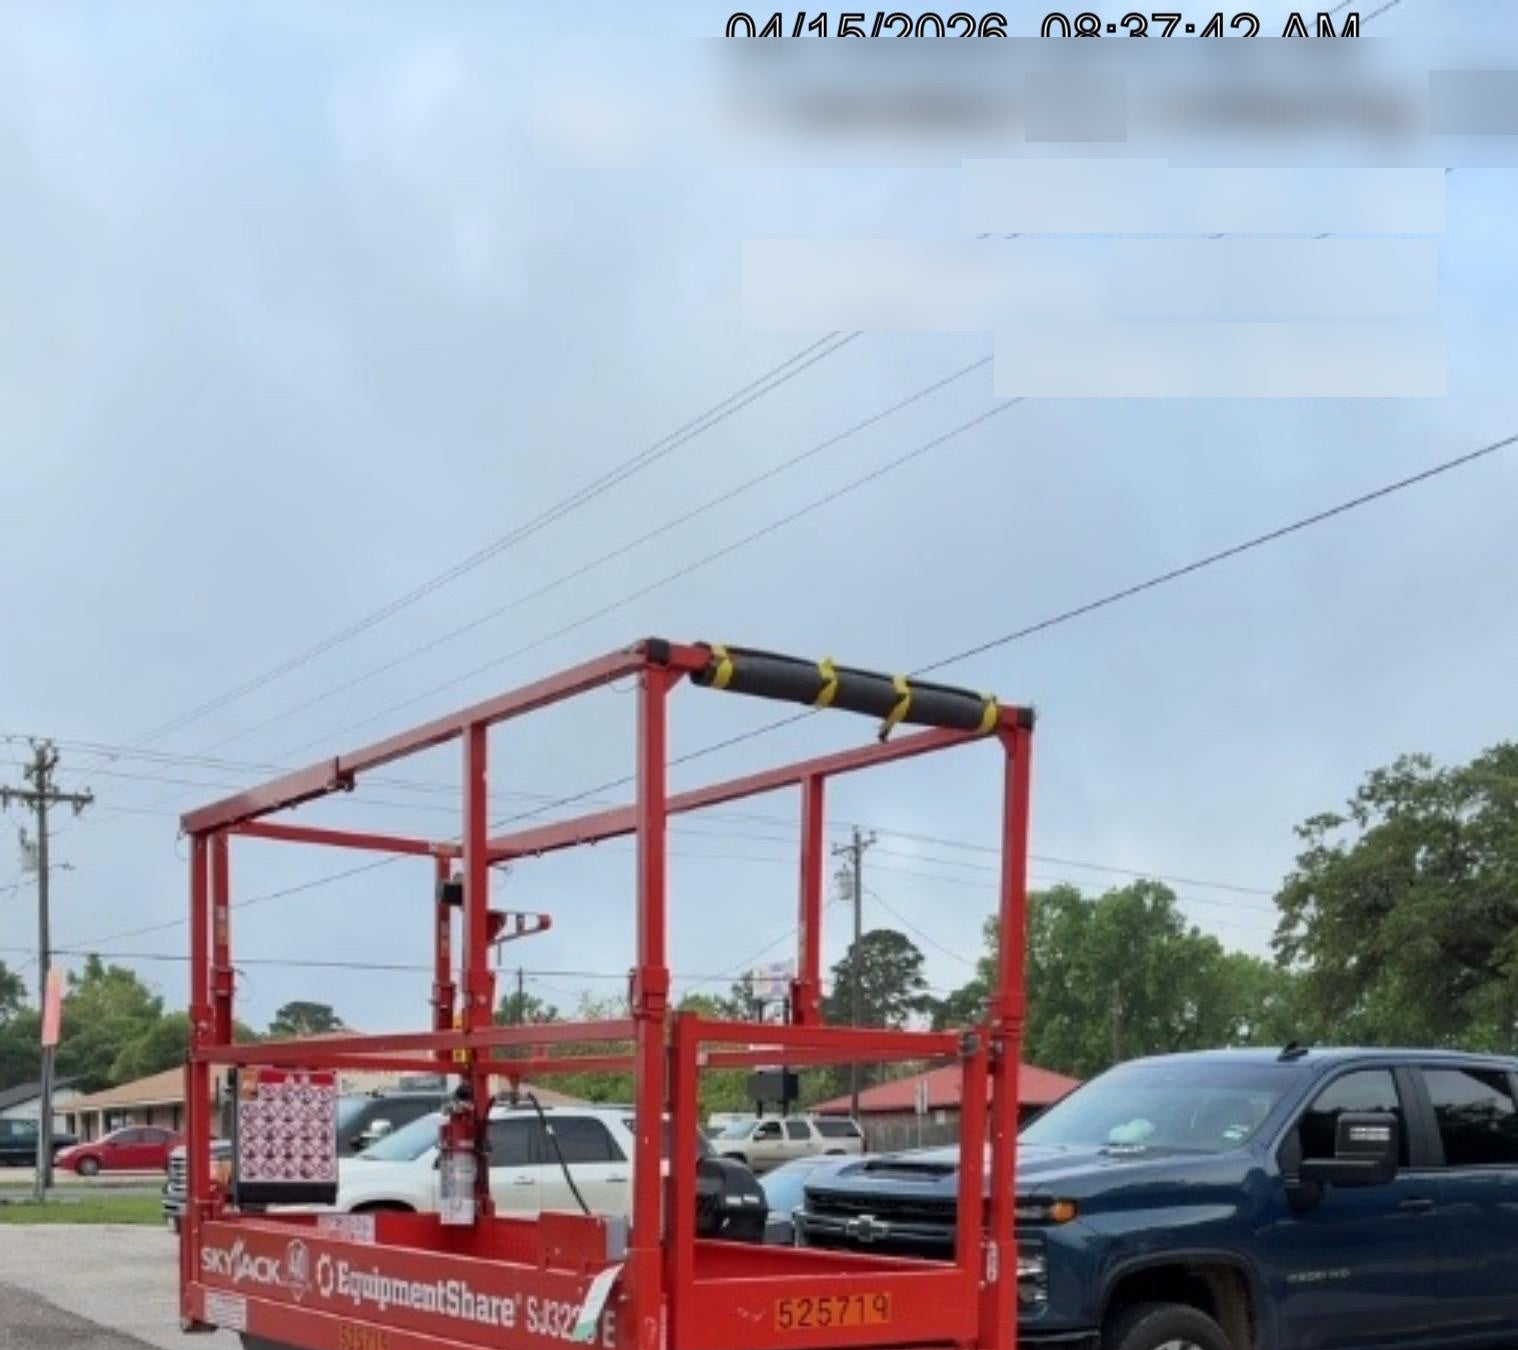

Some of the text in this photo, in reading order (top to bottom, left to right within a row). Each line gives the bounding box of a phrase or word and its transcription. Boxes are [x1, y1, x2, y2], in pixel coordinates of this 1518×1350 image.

[200, 1237, 281, 1285] SKYJACK
[336, 1266, 516, 1328] EquipmentShare
[778, 1296, 889, 1329] 525719
